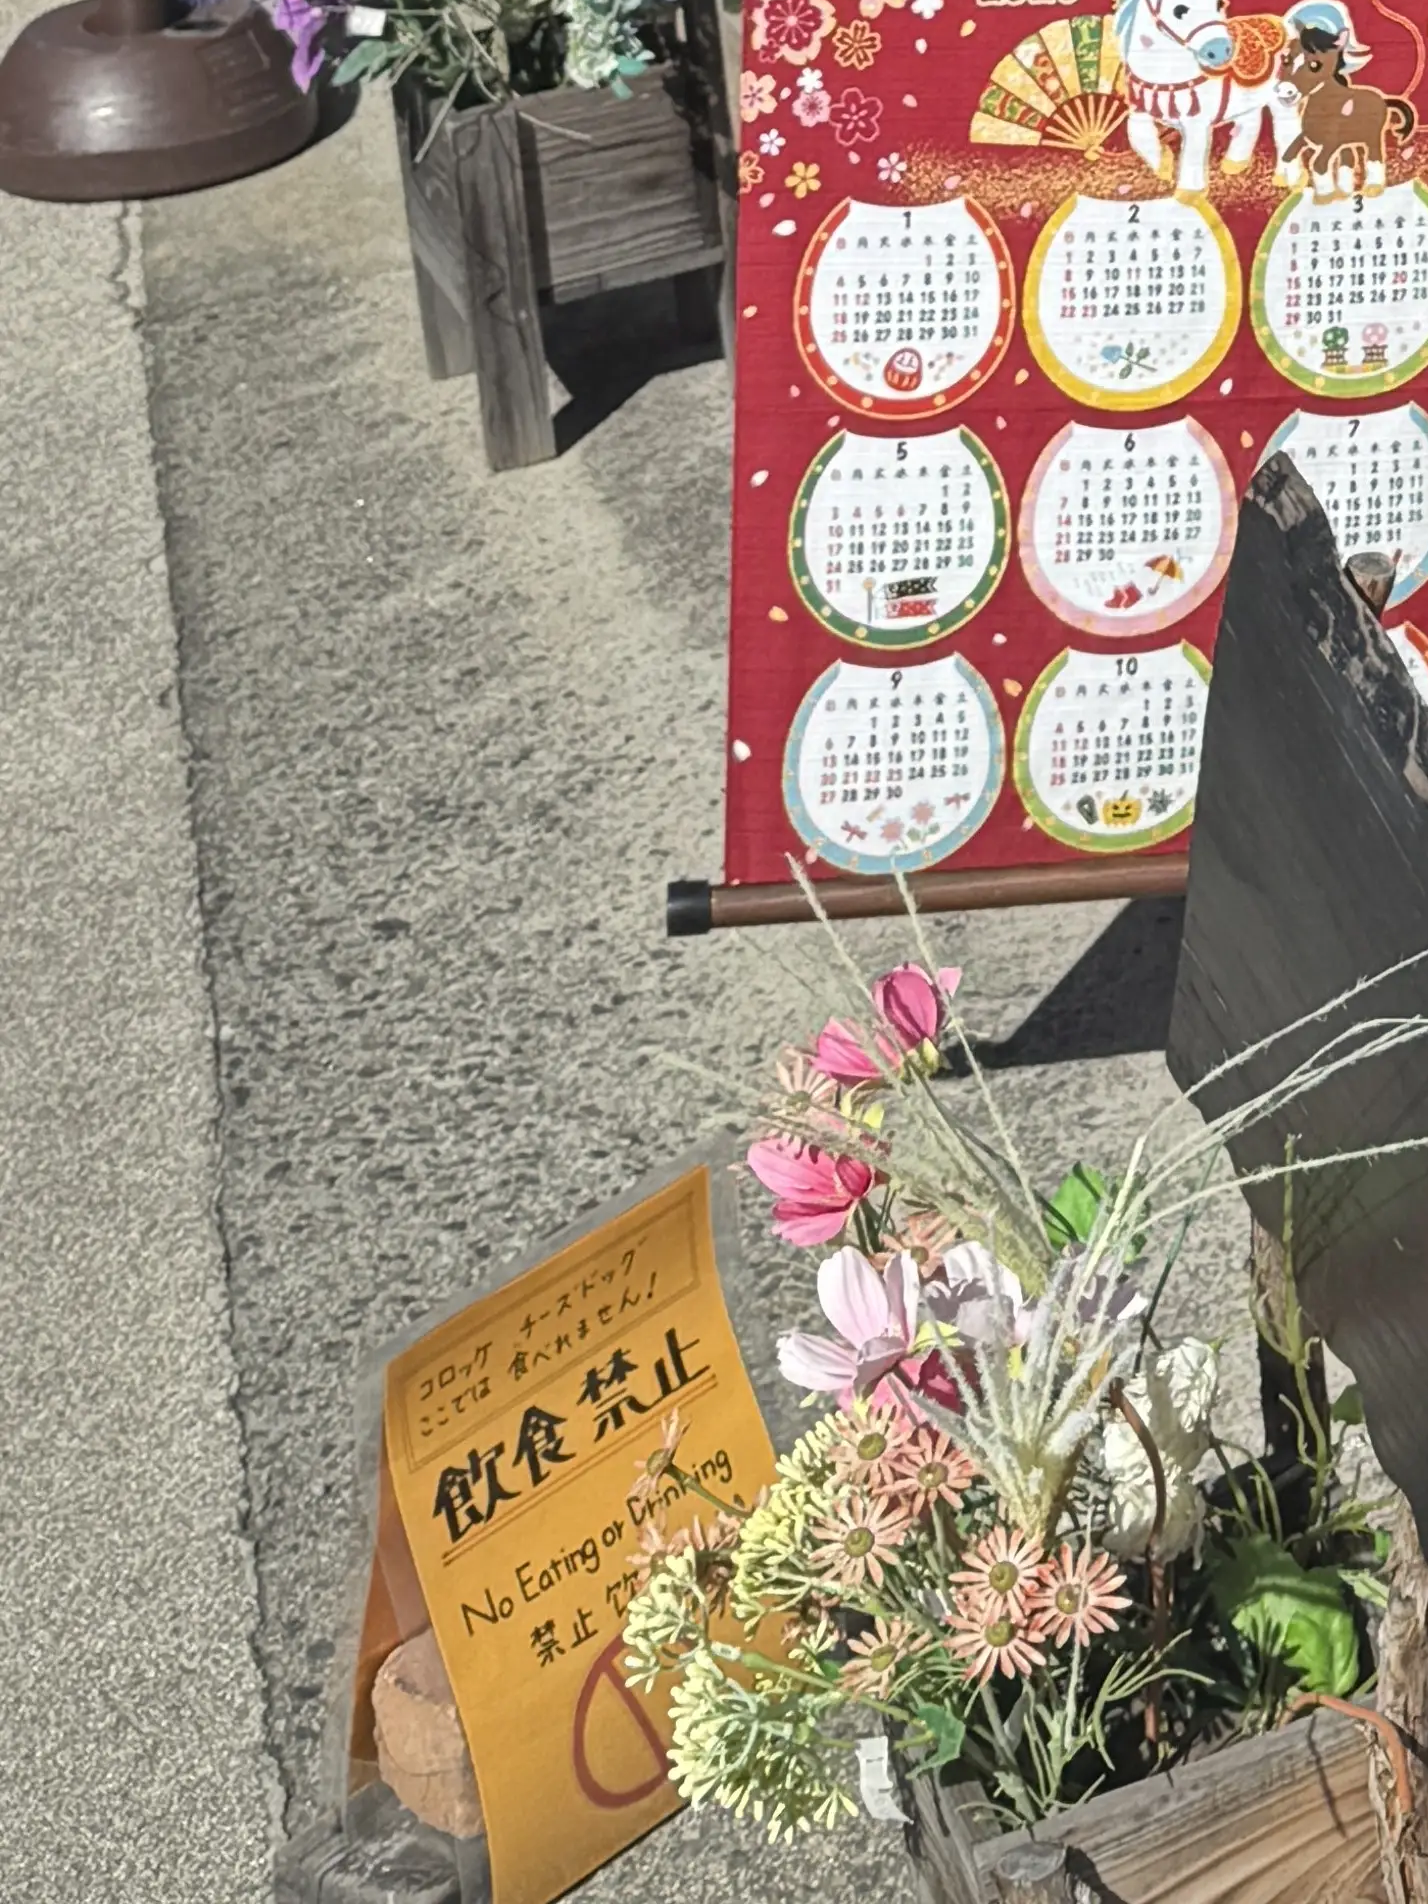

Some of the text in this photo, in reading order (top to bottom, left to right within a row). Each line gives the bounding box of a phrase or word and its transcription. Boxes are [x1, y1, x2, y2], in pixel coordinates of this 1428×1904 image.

[1127, 203, 1140, 223] 2
[1352, 194, 1363, 213] 3
[902, 210, 912, 229] 1
[1291, 234, 1425, 255] 1 2 3 4 5 6 7
[1066, 246, 1202, 264] 1 2 3 4 5 6 7
[1290, 251, 1428, 272] 8 9 10 11 12 13 14
[1065, 264, 1205, 282] 8 9 10 11 12 13 14
[1287, 269, 1427, 290] 15 16 17 18 19 20 21
[1062, 283, 1204, 300] 15 16 17 18 19 20 21
[1286, 287, 1427, 307] 22 23 24 25 26 27 28
[1060, 300, 1205, 318] 22 23 24 25 26 27 28
[1285, 310, 1342, 326] 29 30 31
[1348, 419, 1360, 438] 7
[896, 441, 908, 460] 5
[1124, 432, 1136, 452] 6
[1115, 657, 1138, 676] 10
[890, 670, 903, 690] 9
[419, 1377, 491, 1438] ここでは
[431, 1326, 711, 1544] 飲食禁止
[460, 1588, 515, 1638] No
[514, 1537, 601, 1603] Eating
[601, 1519, 625, 1549] or
